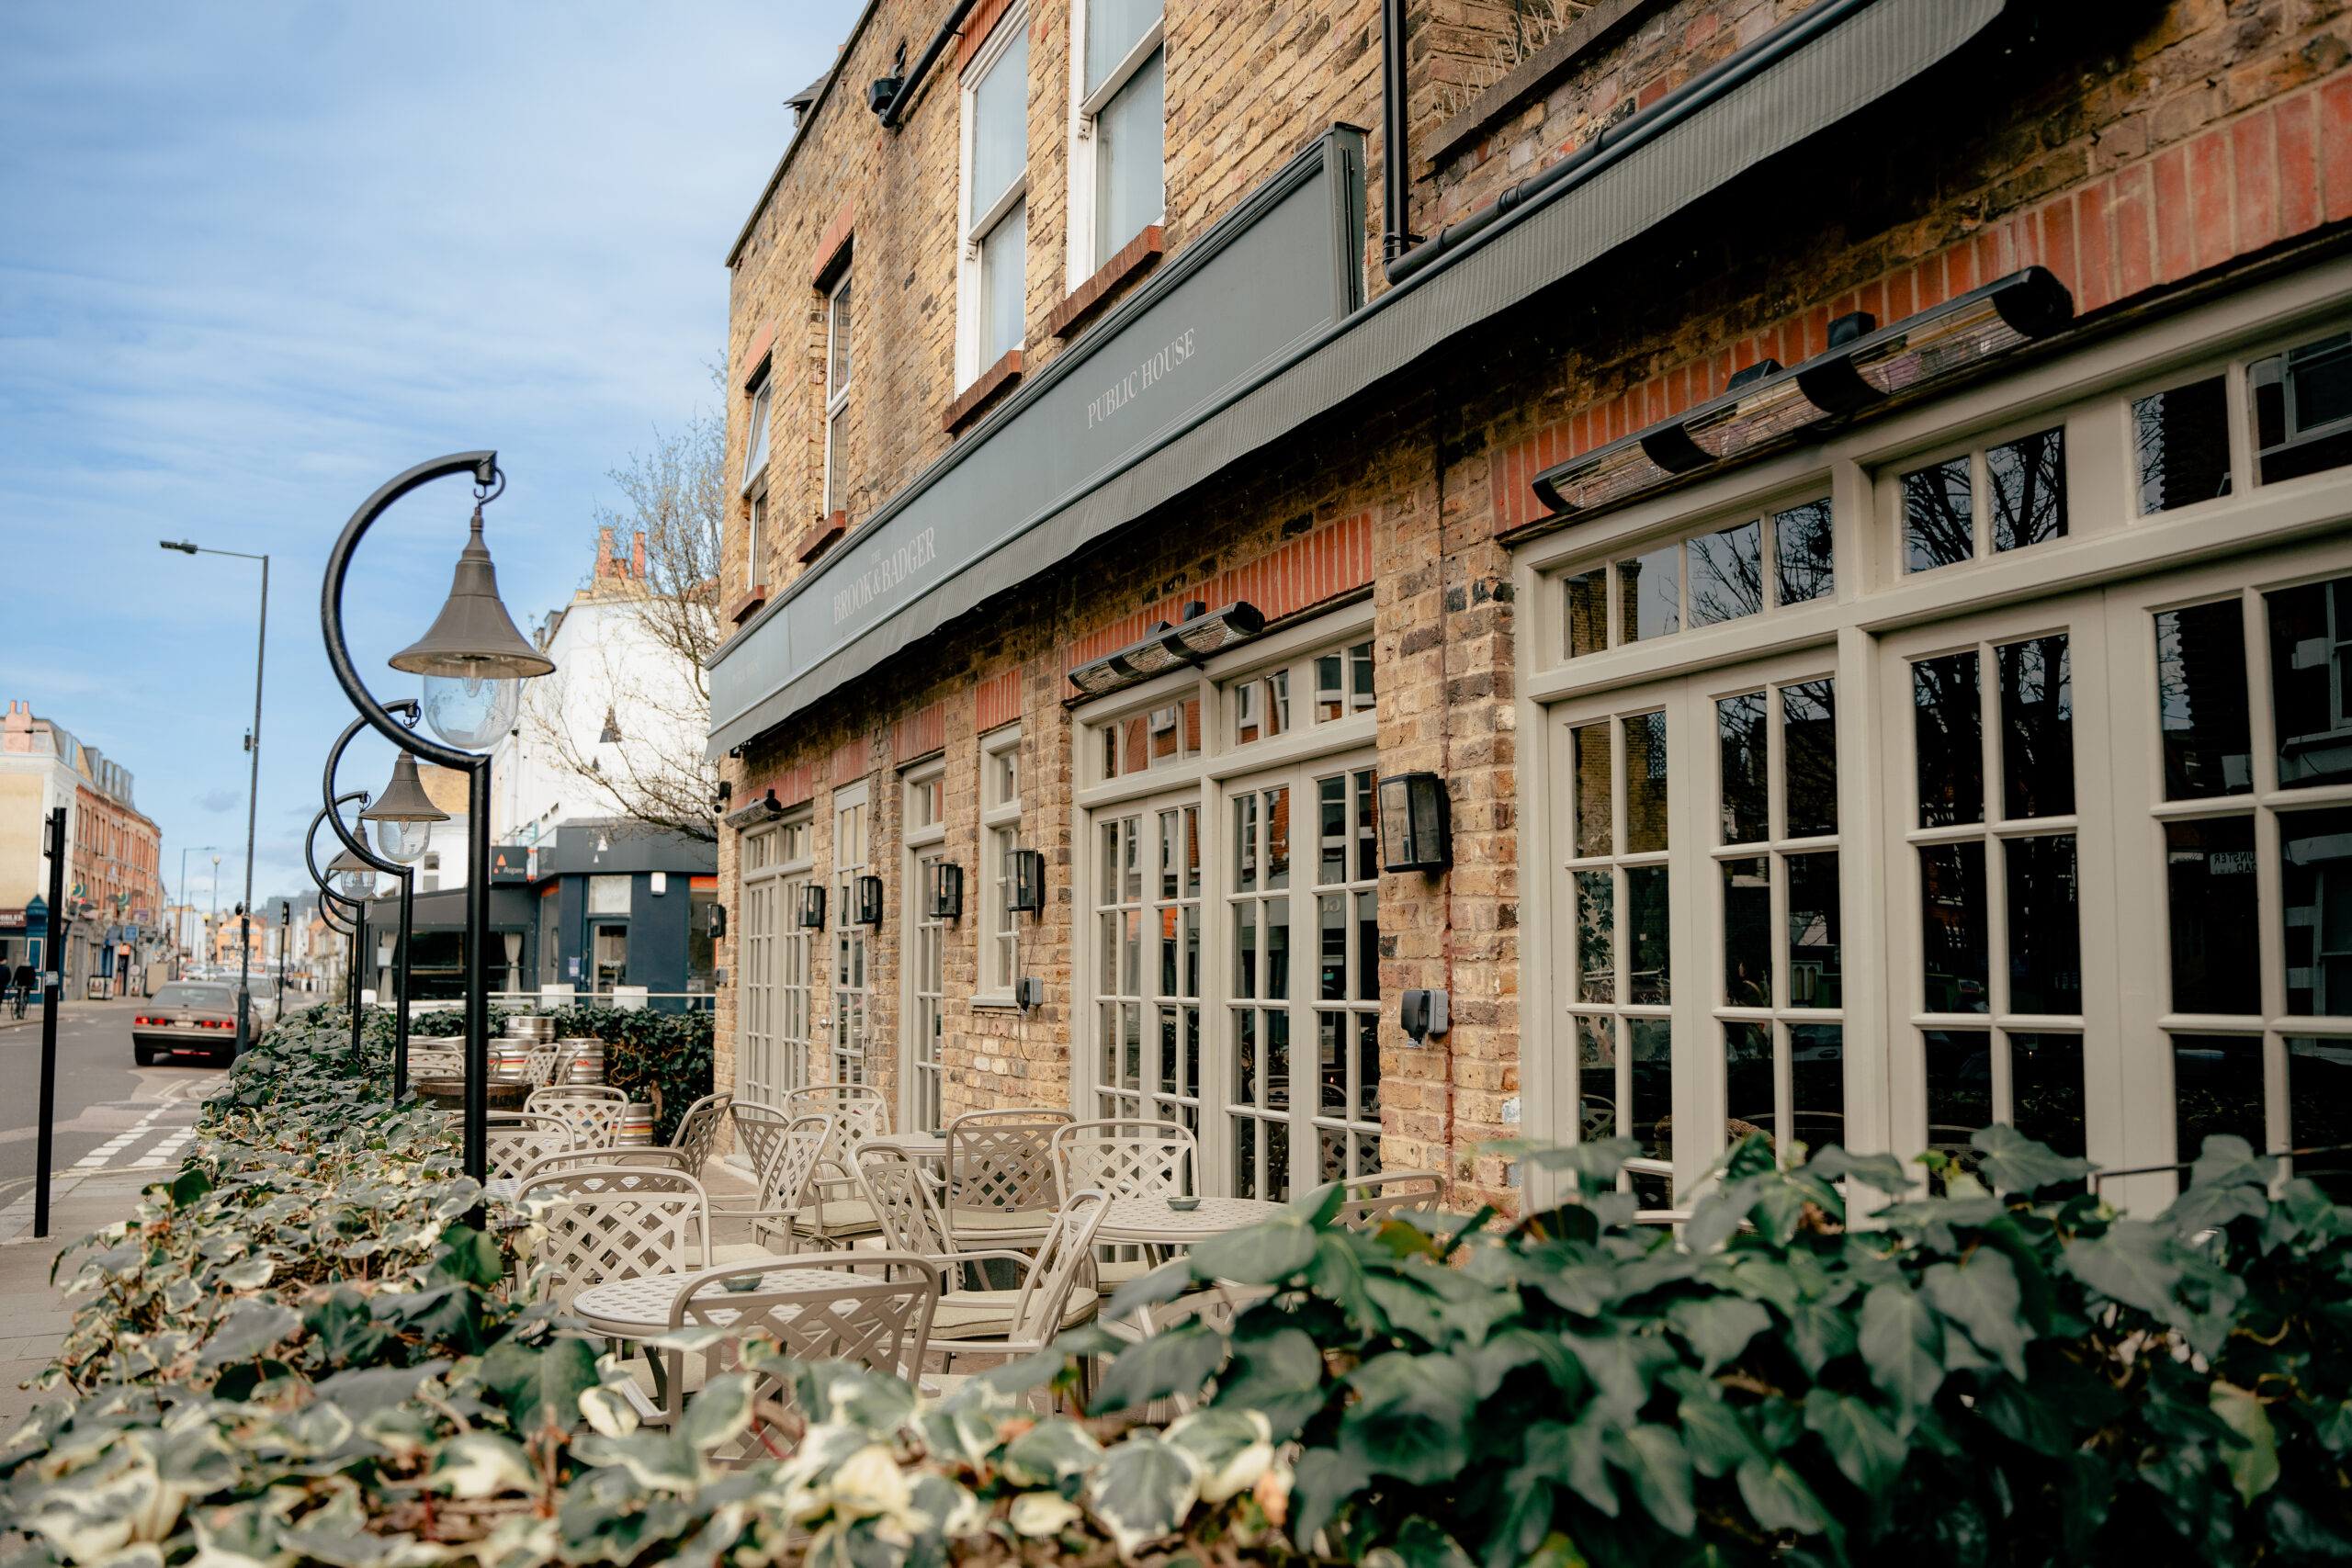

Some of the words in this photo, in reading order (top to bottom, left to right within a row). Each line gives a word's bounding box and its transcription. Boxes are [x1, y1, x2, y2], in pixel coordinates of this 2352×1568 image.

[1088, 371, 1137, 429] PUBLIC
[1141, 328, 1195, 390] HOUSE
[833, 570, 874, 625] BROOK
[881, 526, 936, 593] BADGER
